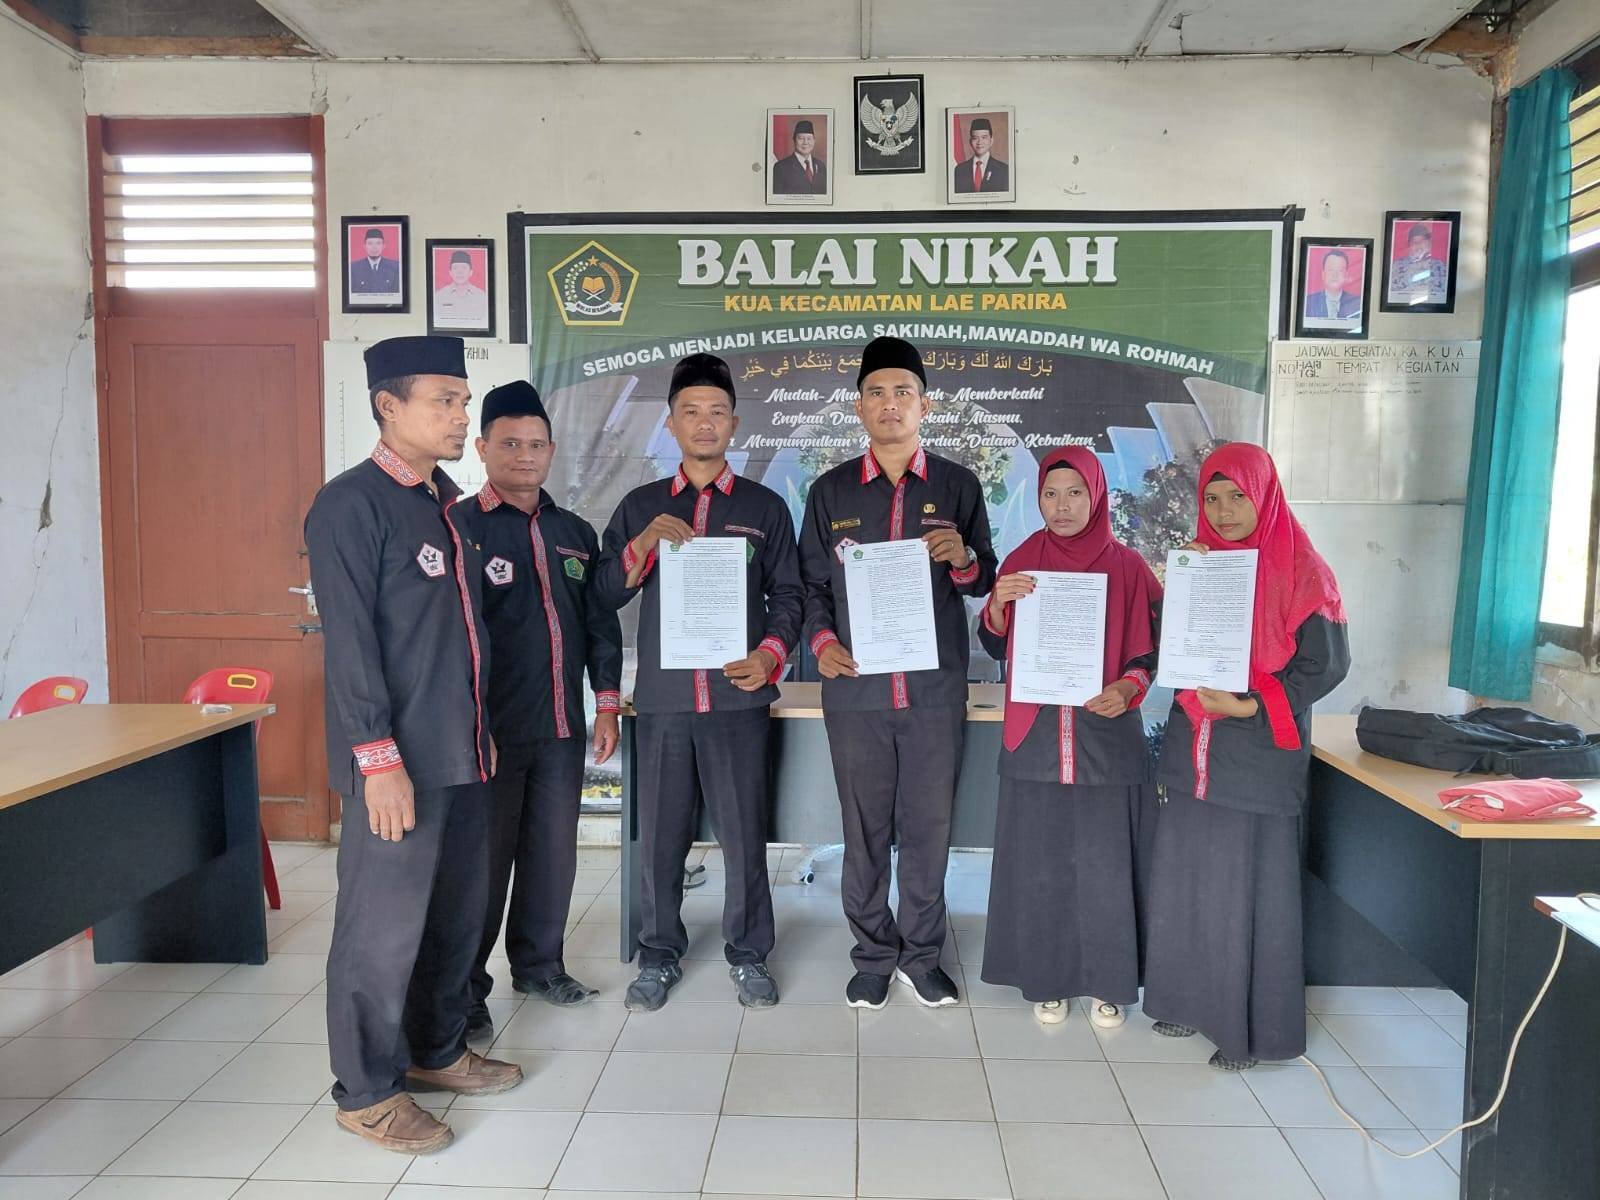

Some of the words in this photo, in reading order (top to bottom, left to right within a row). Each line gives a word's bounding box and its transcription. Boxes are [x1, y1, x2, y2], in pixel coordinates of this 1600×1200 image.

[678, 238, 877, 286] BALAI
[899, 237, 1118, 285] NIKAH
[724, 295, 773, 312] KUA
[780, 294, 922, 312] KECAMATAN
[930, 294, 974, 311] LAE
[981, 293, 1067, 311] PARIRA
[583, 349, 664, 377] SEMOGA
[669, 333, 755, 357] MENJADI
[762, 324, 868, 345] KELUARGA
[1090, 336, 1121, 356] WA
[1126, 343, 1215, 375] ROHMAH
[1343, 345, 1396, 358] KEGIATAN
[1335, 361, 1380, 374] TEMPAT
[1397, 361, 1460, 374] KEGIATAN
[952, 387, 1045, 402] Memberkahi
[772, 411, 825, 427] Engkau
[740, 434, 851, 450] Mengumpulkan
[967, 434, 1018, 448] Dalam
